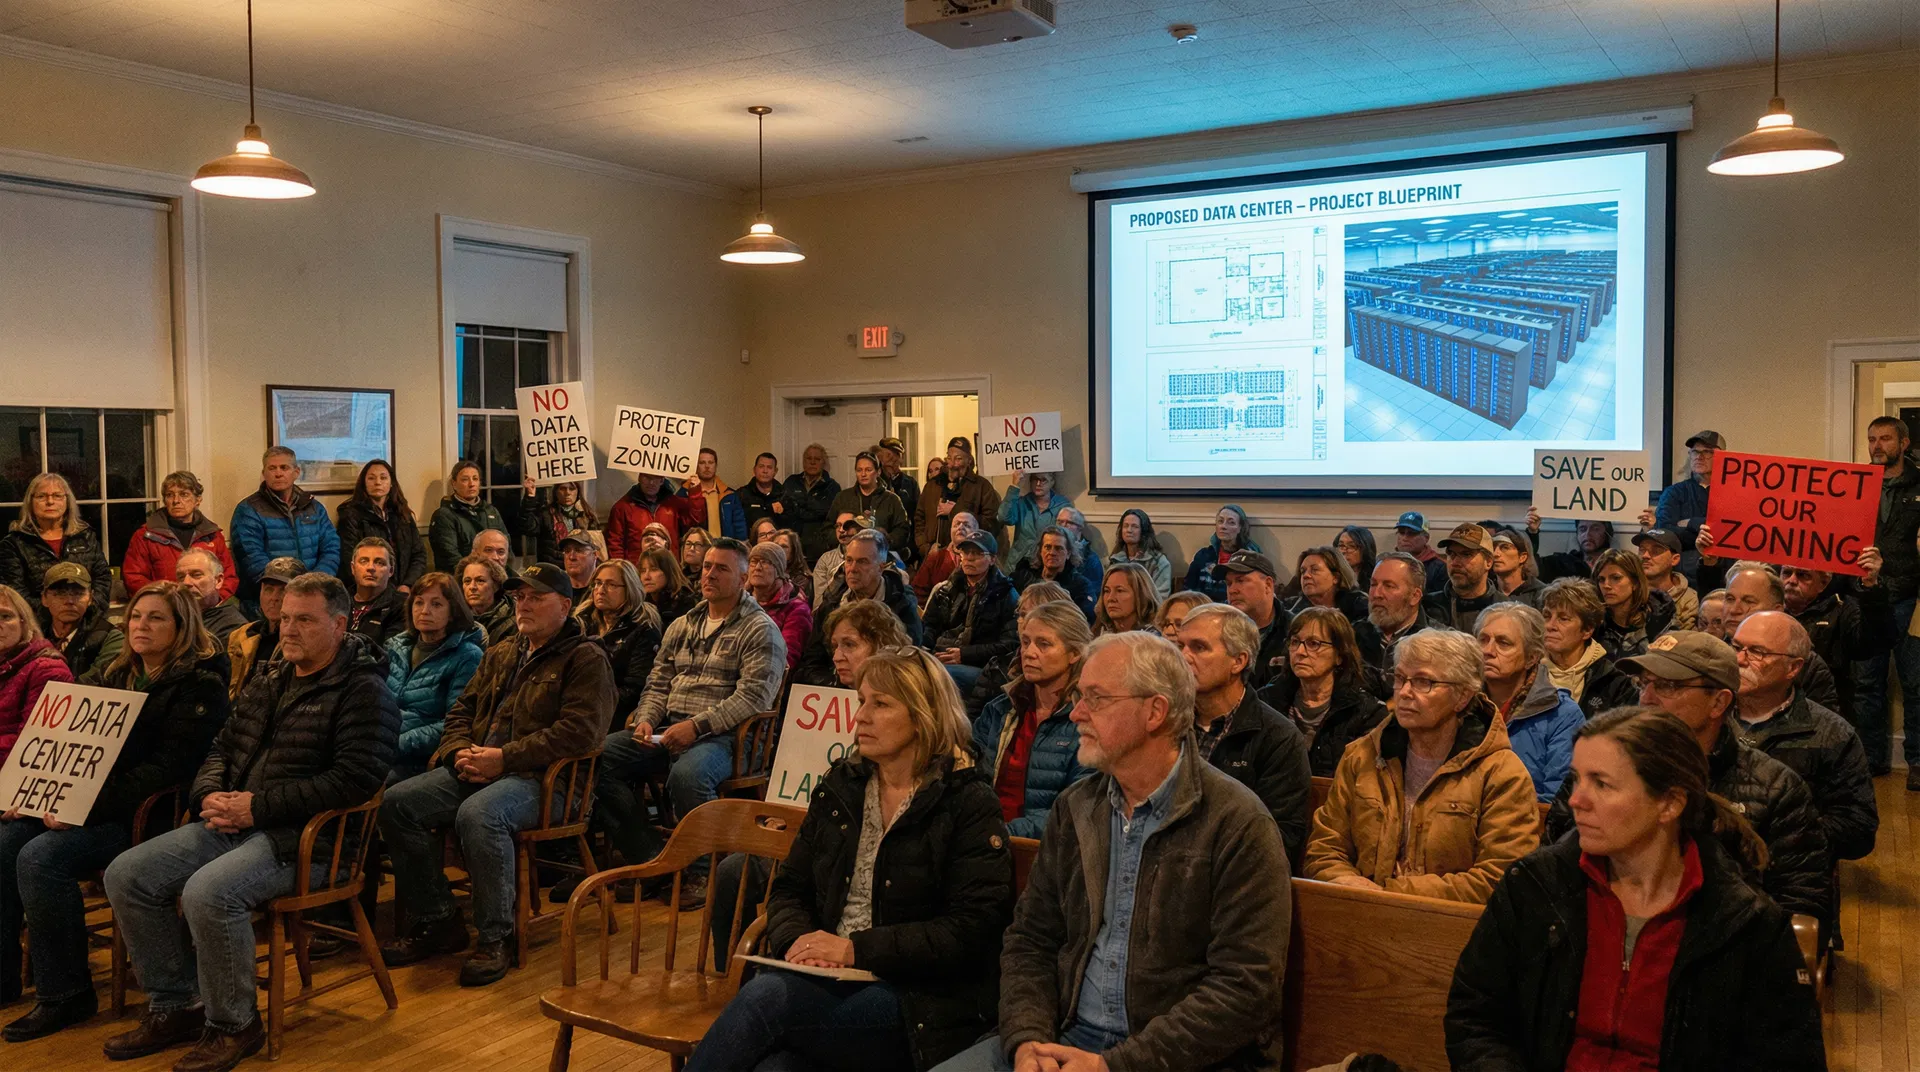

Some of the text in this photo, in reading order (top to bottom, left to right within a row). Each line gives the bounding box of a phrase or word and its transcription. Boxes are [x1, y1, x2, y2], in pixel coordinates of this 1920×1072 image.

[1130, 208, 1199, 228] PROPOSED
[1203, 205, 1236, 221] DATA
[1240, 199, 1293, 218] CENTER
[1309, 191, 1374, 212] PROJECT
[1378, 183, 1462, 206] BLUEPRINT
[863, 326, 889, 349] EXIT
[532, 388, 569, 413] NO
[531, 414, 580, 437] DATA
[618, 409, 700, 437] PROTECT
[1004, 416, 1036, 437] NO
[526, 435, 590, 457] CENTER
[640, 433, 670, 450] OUR
[985, 438, 1060, 455] DATA CENTER
[537, 456, 586, 479] HERE
[613, 446, 691, 474] ZONING
[1004, 454, 1040, 471] HERE
[1540, 455, 1645, 482] SAVE OUR
[1720, 457, 1874, 501] PROTECT
[1553, 486, 1627, 512] LAND
[1758, 497, 1817, 523] OUR
[1716, 518, 1862, 566] ZONING
[30, 693, 130, 738] NO DATA
[796, 693, 858, 734] SAV
[19, 736, 105, 780] CENTER
[11, 775, 73, 814] HERE
[778, 770, 822, 803] LA
